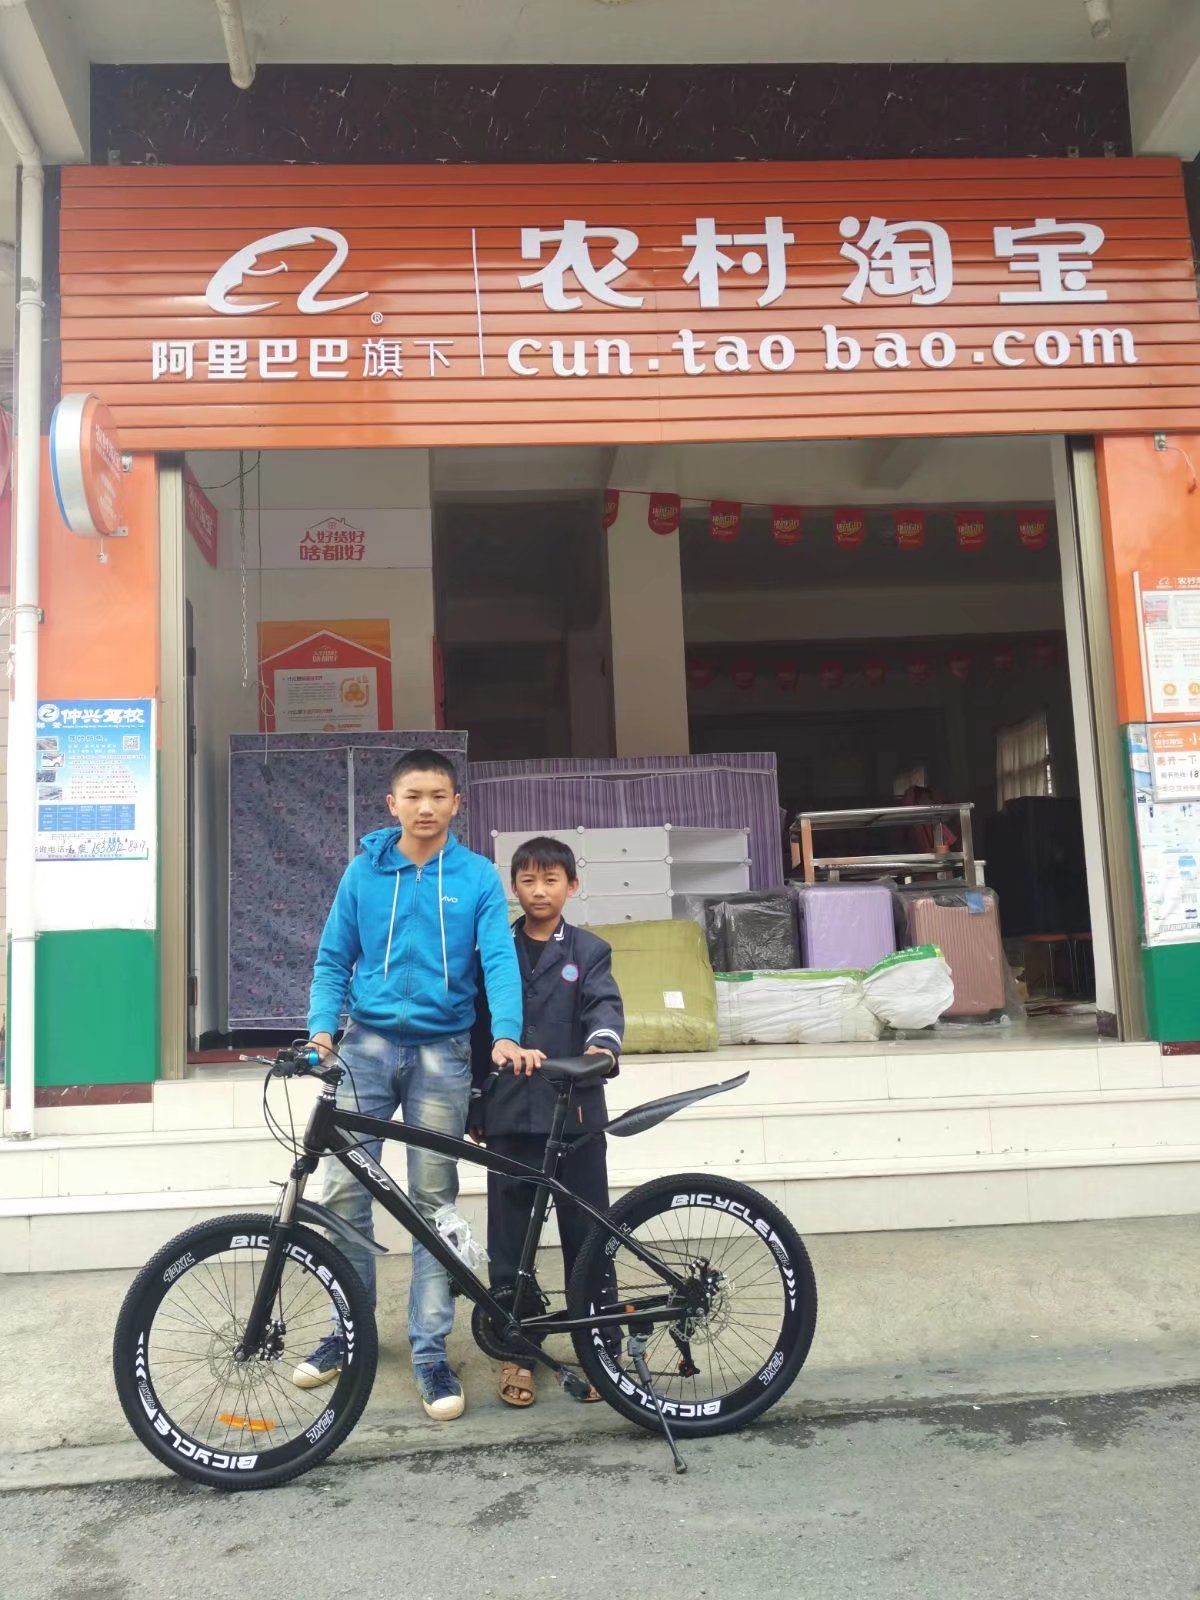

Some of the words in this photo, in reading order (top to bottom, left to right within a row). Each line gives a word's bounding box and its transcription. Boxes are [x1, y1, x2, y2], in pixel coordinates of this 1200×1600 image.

[518, 215, 1108, 312] 农村淘宝
[151, 338, 454, 380] 阿里巴巴旗下
[670, 1192, 772, 1239] BICYCLE
[154, 1413, 259, 1470] BICYCLE
